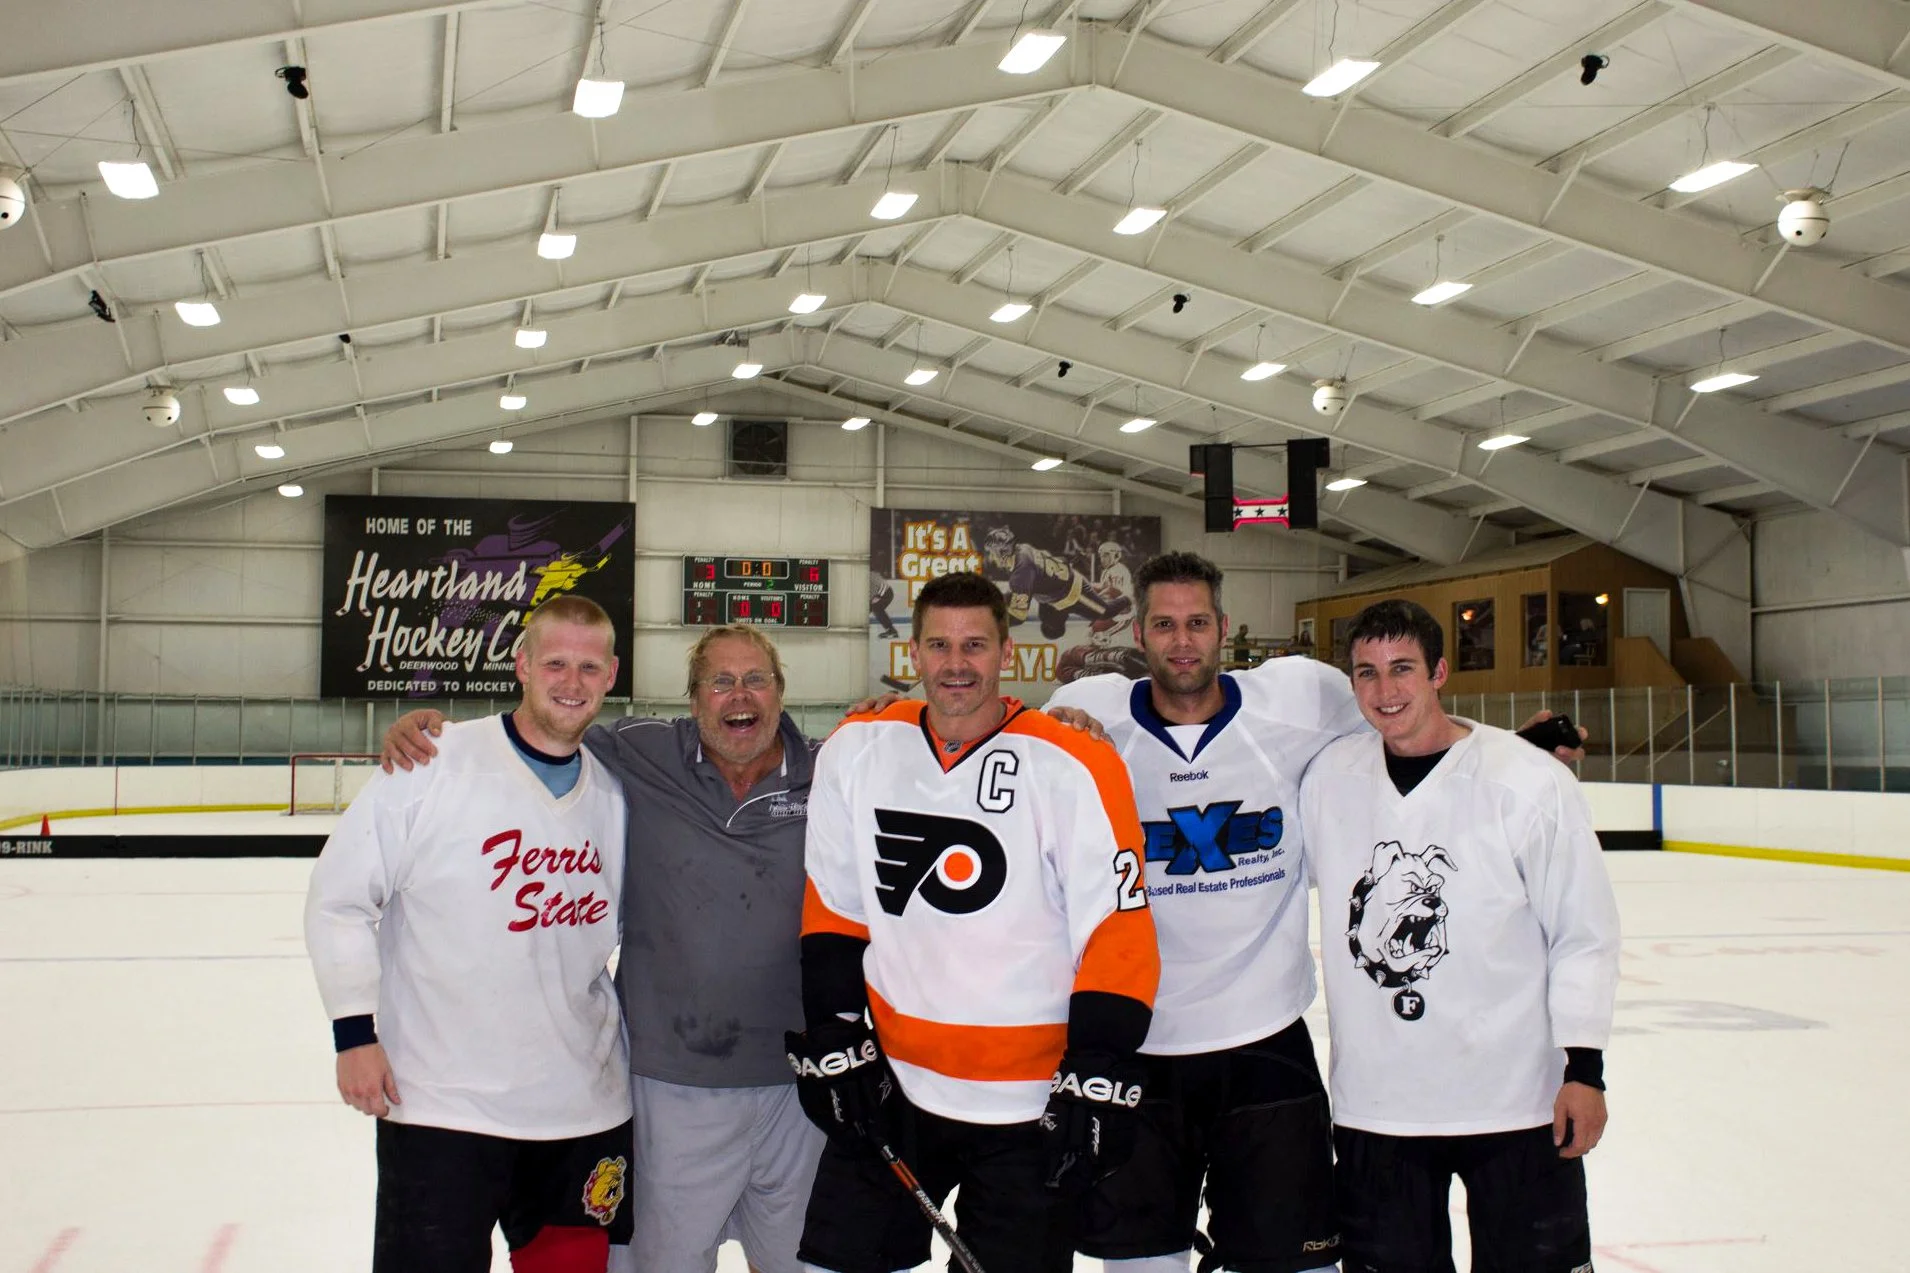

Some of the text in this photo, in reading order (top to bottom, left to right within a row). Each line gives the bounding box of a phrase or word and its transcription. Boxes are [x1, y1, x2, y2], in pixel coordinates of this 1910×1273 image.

[366, 517, 472, 537] HOME OF THE
[907, 523, 969, 550] It's A
[335, 549, 527, 618] Heartland
[693, 581, 716, 589] HOME
[794, 583, 823, 592] VISITOR
[356, 605, 484, 673] Hockey
[399, 661, 516, 671] DEERWOOD MINNE
[367, 680, 516, 692] DEDICATED TO HOCKEY
[977, 749, 1019, 813] C
[1169, 770, 1209, 783] Reebok
[0, 841, 53, 854] 9-RINK
[481, 828, 603, 891] Ferris
[1238, 855, 1270, 866] Realty,
[1113, 848, 1148, 912] 2
[1175, 882, 1197, 895] Real
[1198, 879, 1228, 892] Estate
[1230, 868, 1286, 890] Professionals
[507, 881, 609, 932] State
[1401, 995, 1420, 1015] F
